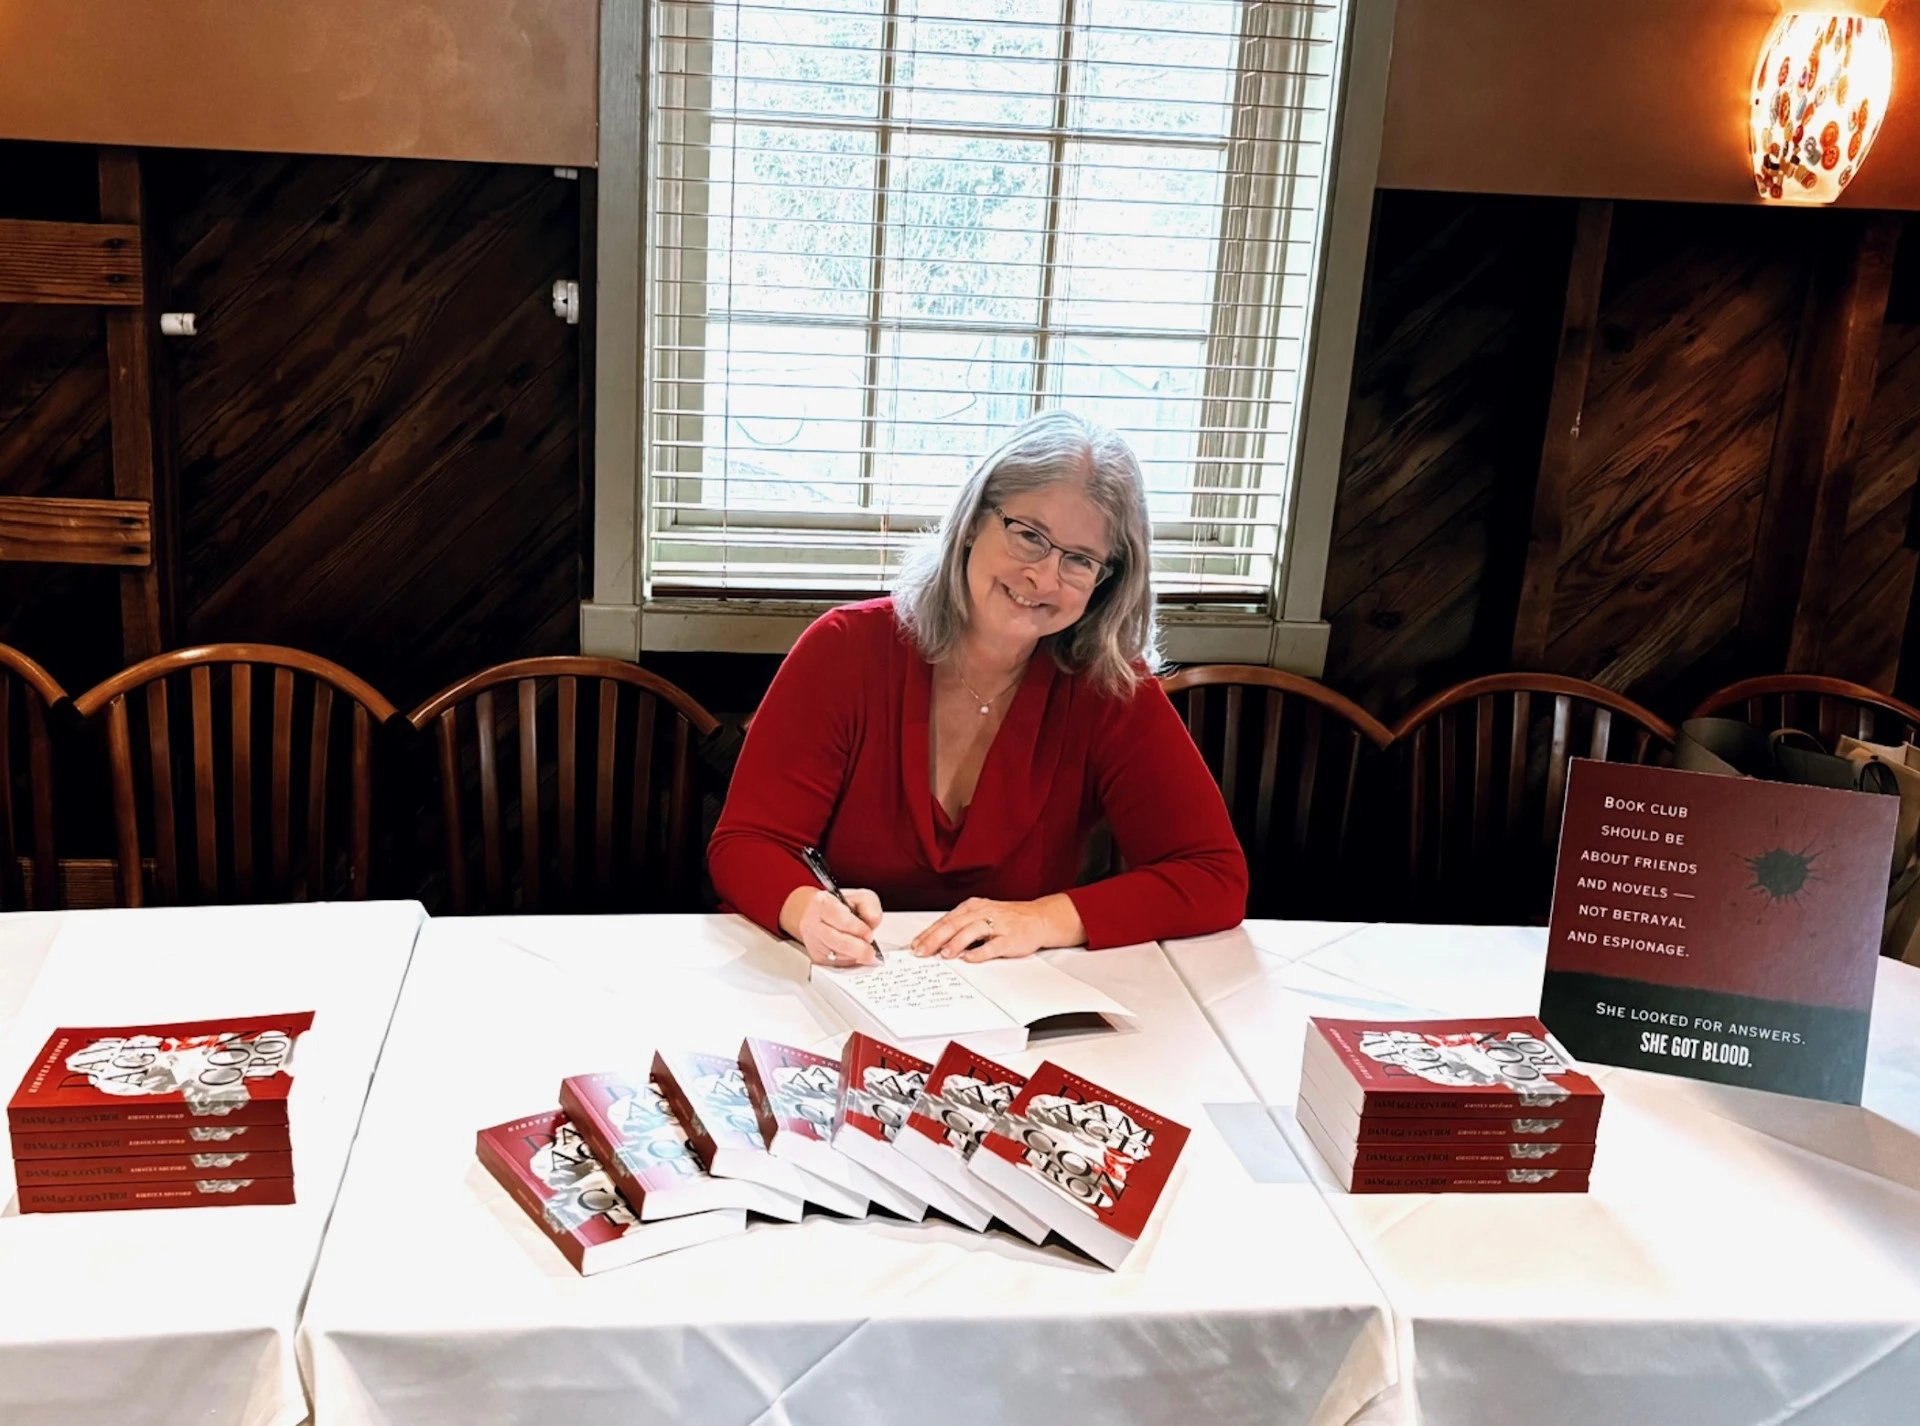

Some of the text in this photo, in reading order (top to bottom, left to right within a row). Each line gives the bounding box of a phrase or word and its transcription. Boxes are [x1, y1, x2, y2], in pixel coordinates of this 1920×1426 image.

[1604, 796, 1688, 818] BOOK CLUB
[1601, 824, 1685, 845] SHOULD BE
[1580, 850, 1698, 875] ABOUT FRIENDS
[1577, 877, 1607, 891] AND
[1612, 881, 1668, 899] NOVELS
[1579, 904, 1687, 929] NOT BETRAYAL
[1567, 930, 1690, 957] AND ESPIONAGE.
[1596, 1001, 1806, 1045] SHE LOOKED FOR ANSWERS.
[1640, 1031, 1753, 1068] SHE GOT BLOOD.
